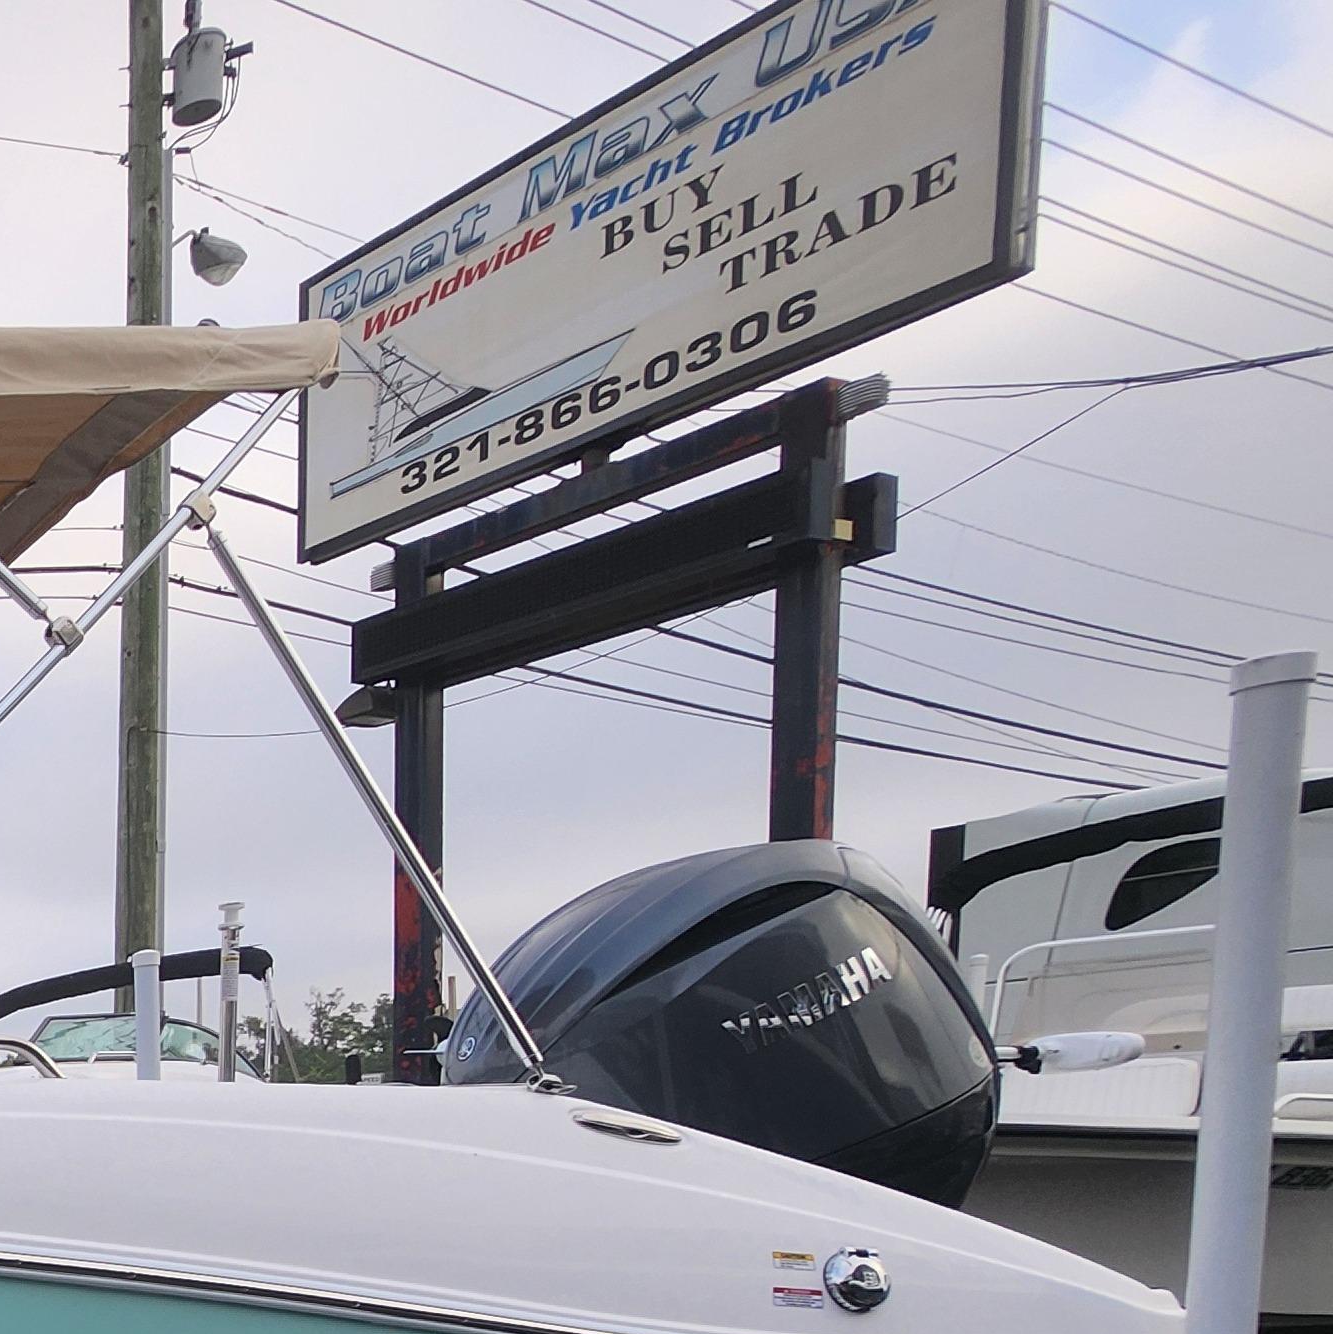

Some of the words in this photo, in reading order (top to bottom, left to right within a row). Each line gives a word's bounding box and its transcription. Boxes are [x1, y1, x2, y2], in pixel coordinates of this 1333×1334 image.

[319, 203, 491, 323] Boat
[517, 72, 720, 224] Max
[362, 222, 556, 342] Worldwide
[570, 143, 699, 231] Yacht
[710, 15, 938, 155] Brokers
[599, 164, 725, 260] BUY
[661, 171, 819, 275] SELL
[719, 152, 958, 295] TRADE
[399, 289, 818, 495] 321-866-0306
[720, 945, 893, 1055] YAMAHA
